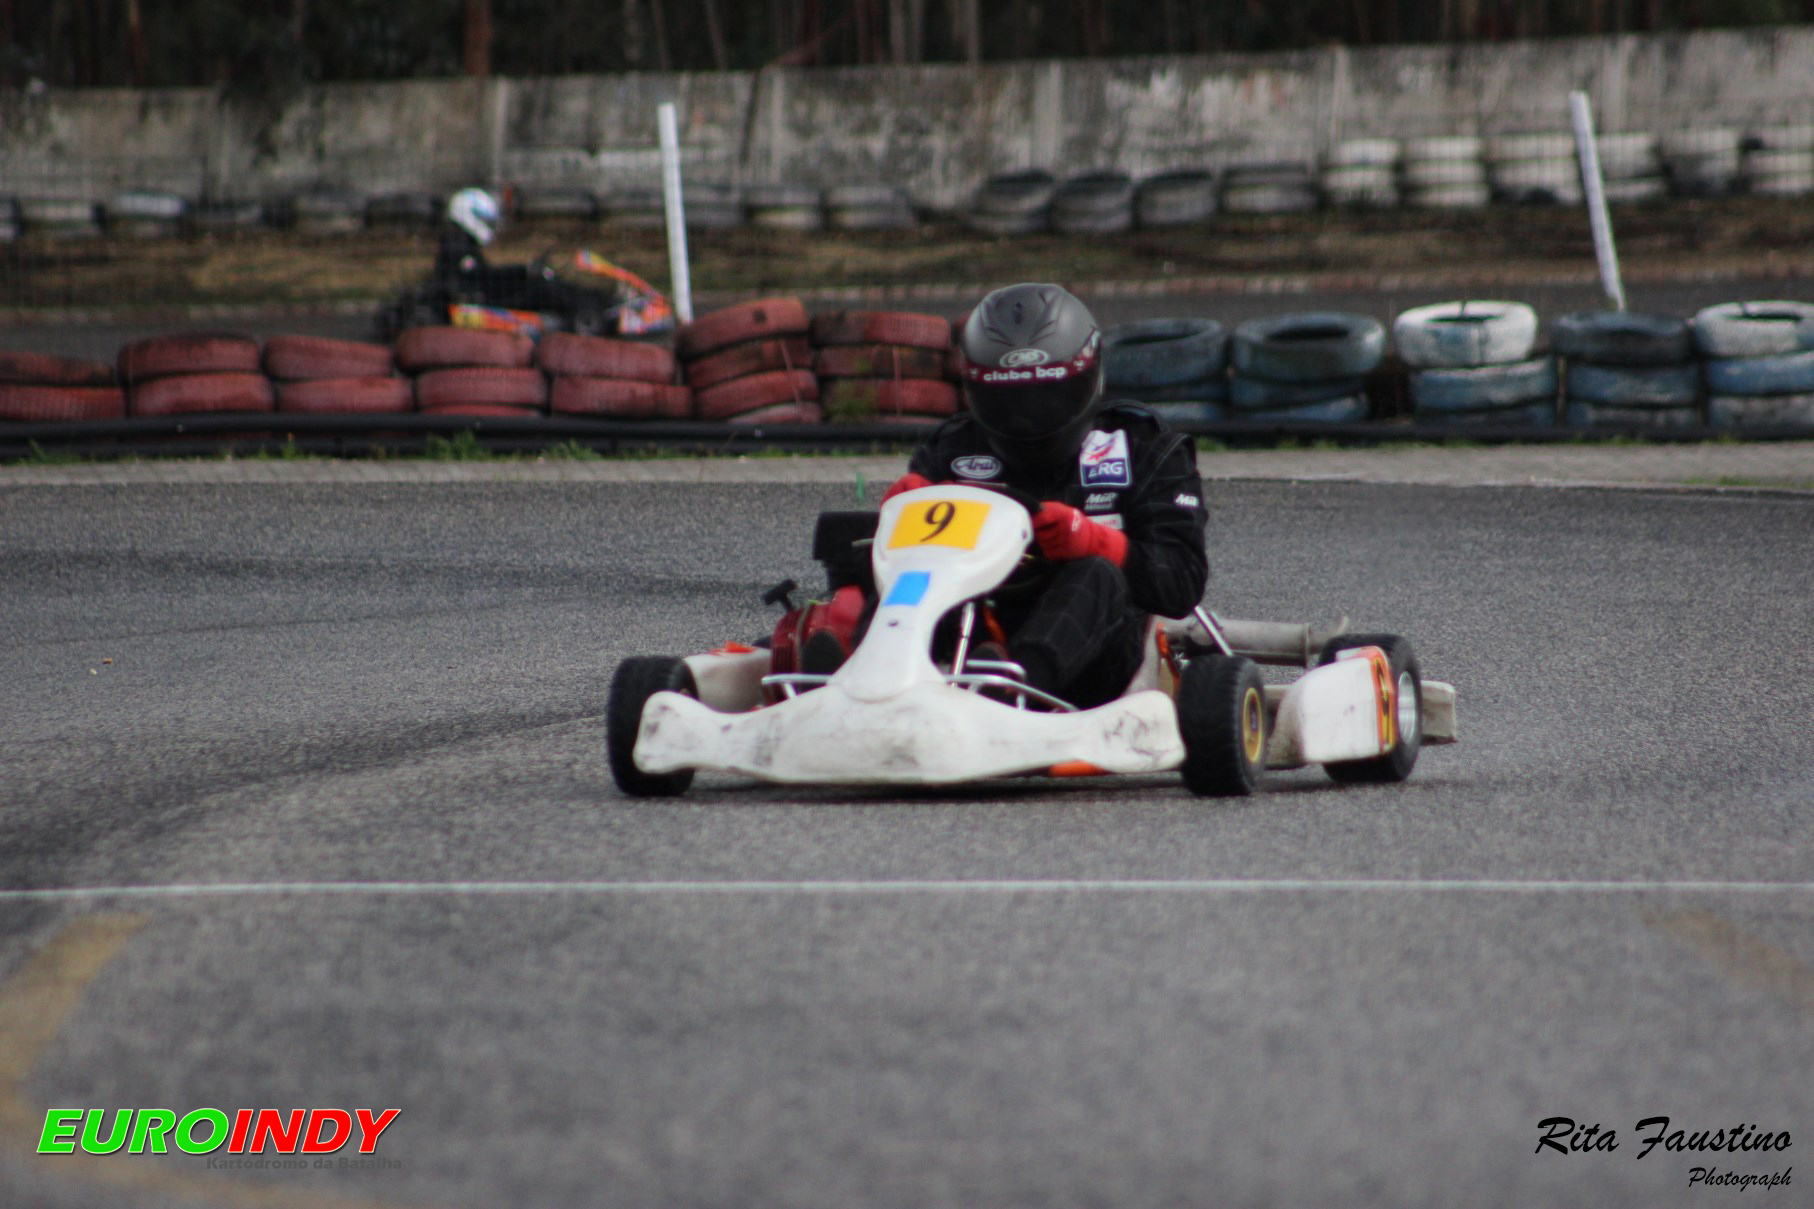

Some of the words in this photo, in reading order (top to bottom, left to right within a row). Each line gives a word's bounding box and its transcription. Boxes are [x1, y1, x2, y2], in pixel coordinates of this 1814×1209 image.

[983, 370, 1032, 381] clube
[1035, 366, 1067, 379] bcp
[1088, 461, 1123, 478] ERG
[920, 501, 956, 542] 9
